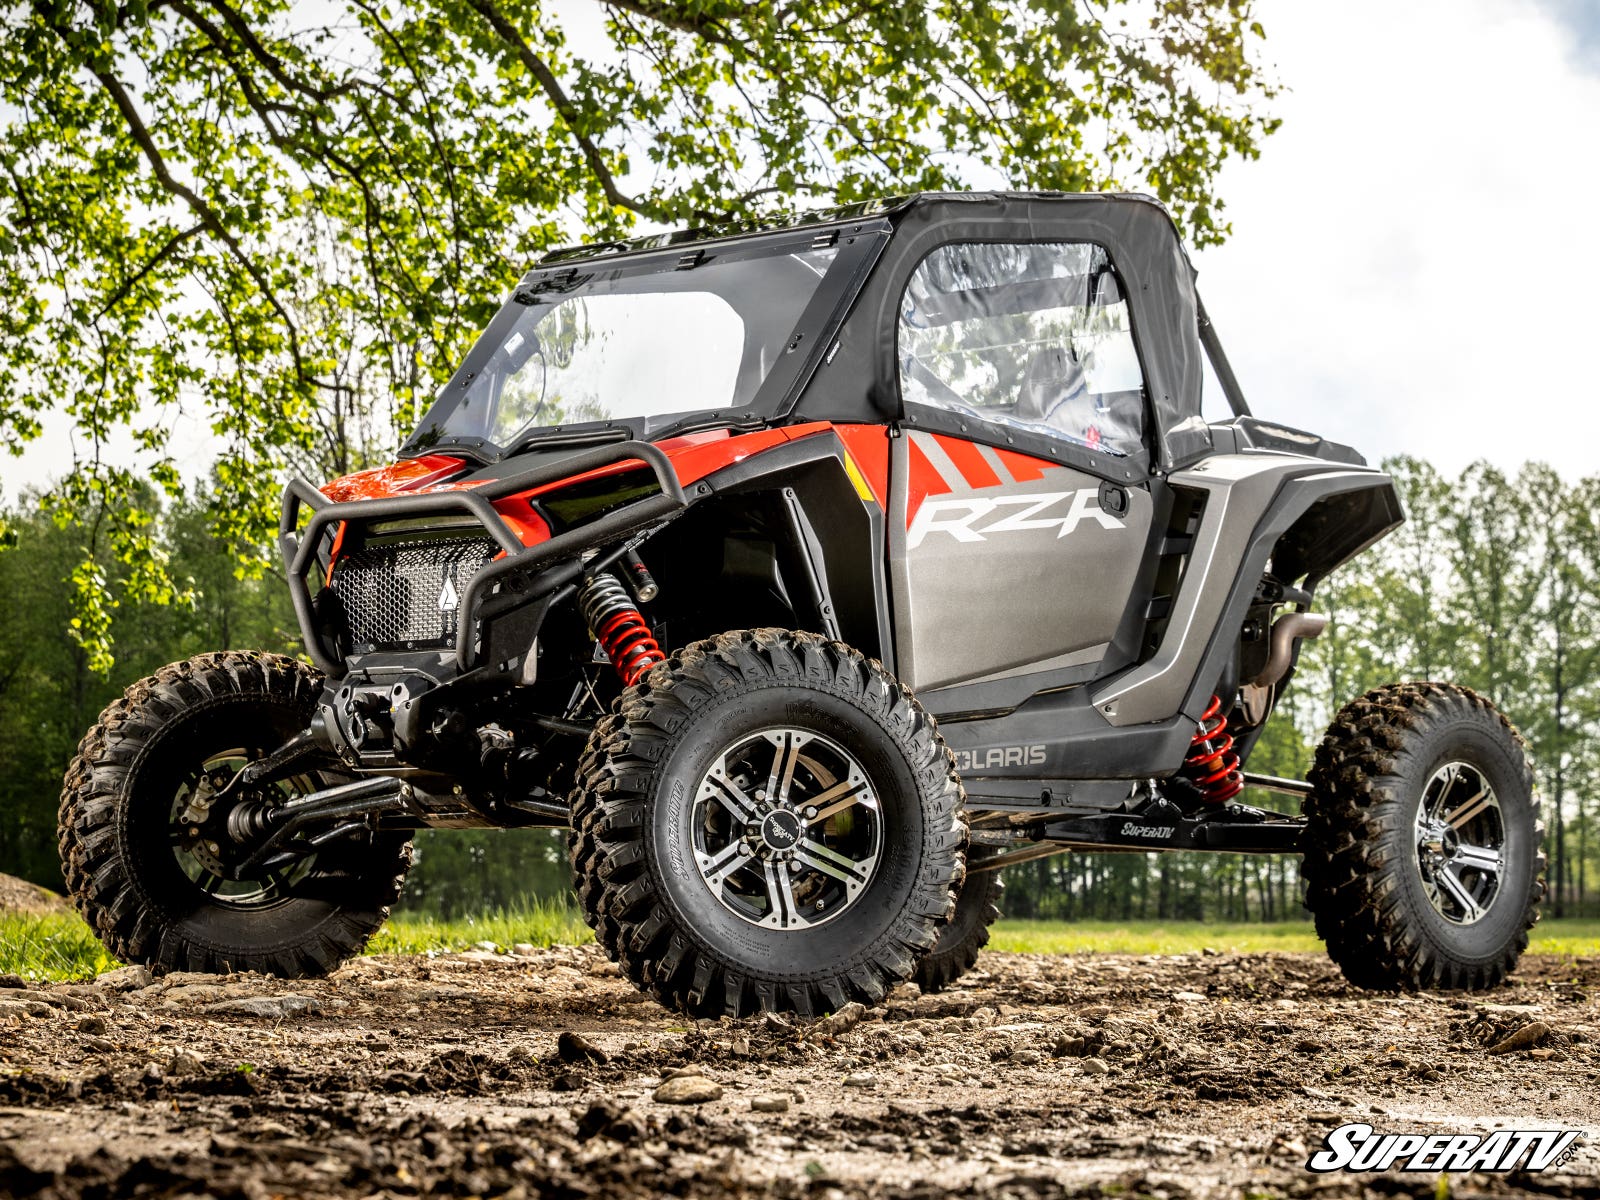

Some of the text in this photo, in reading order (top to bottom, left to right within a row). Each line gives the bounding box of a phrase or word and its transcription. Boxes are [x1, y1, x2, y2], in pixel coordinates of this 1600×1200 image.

[906, 487, 1134, 551] RZR
[955, 745, 1047, 771] OLARIS
[667, 779, 690, 881] SUPERATV
[1121, 822, 1175, 838] SUPERATV
